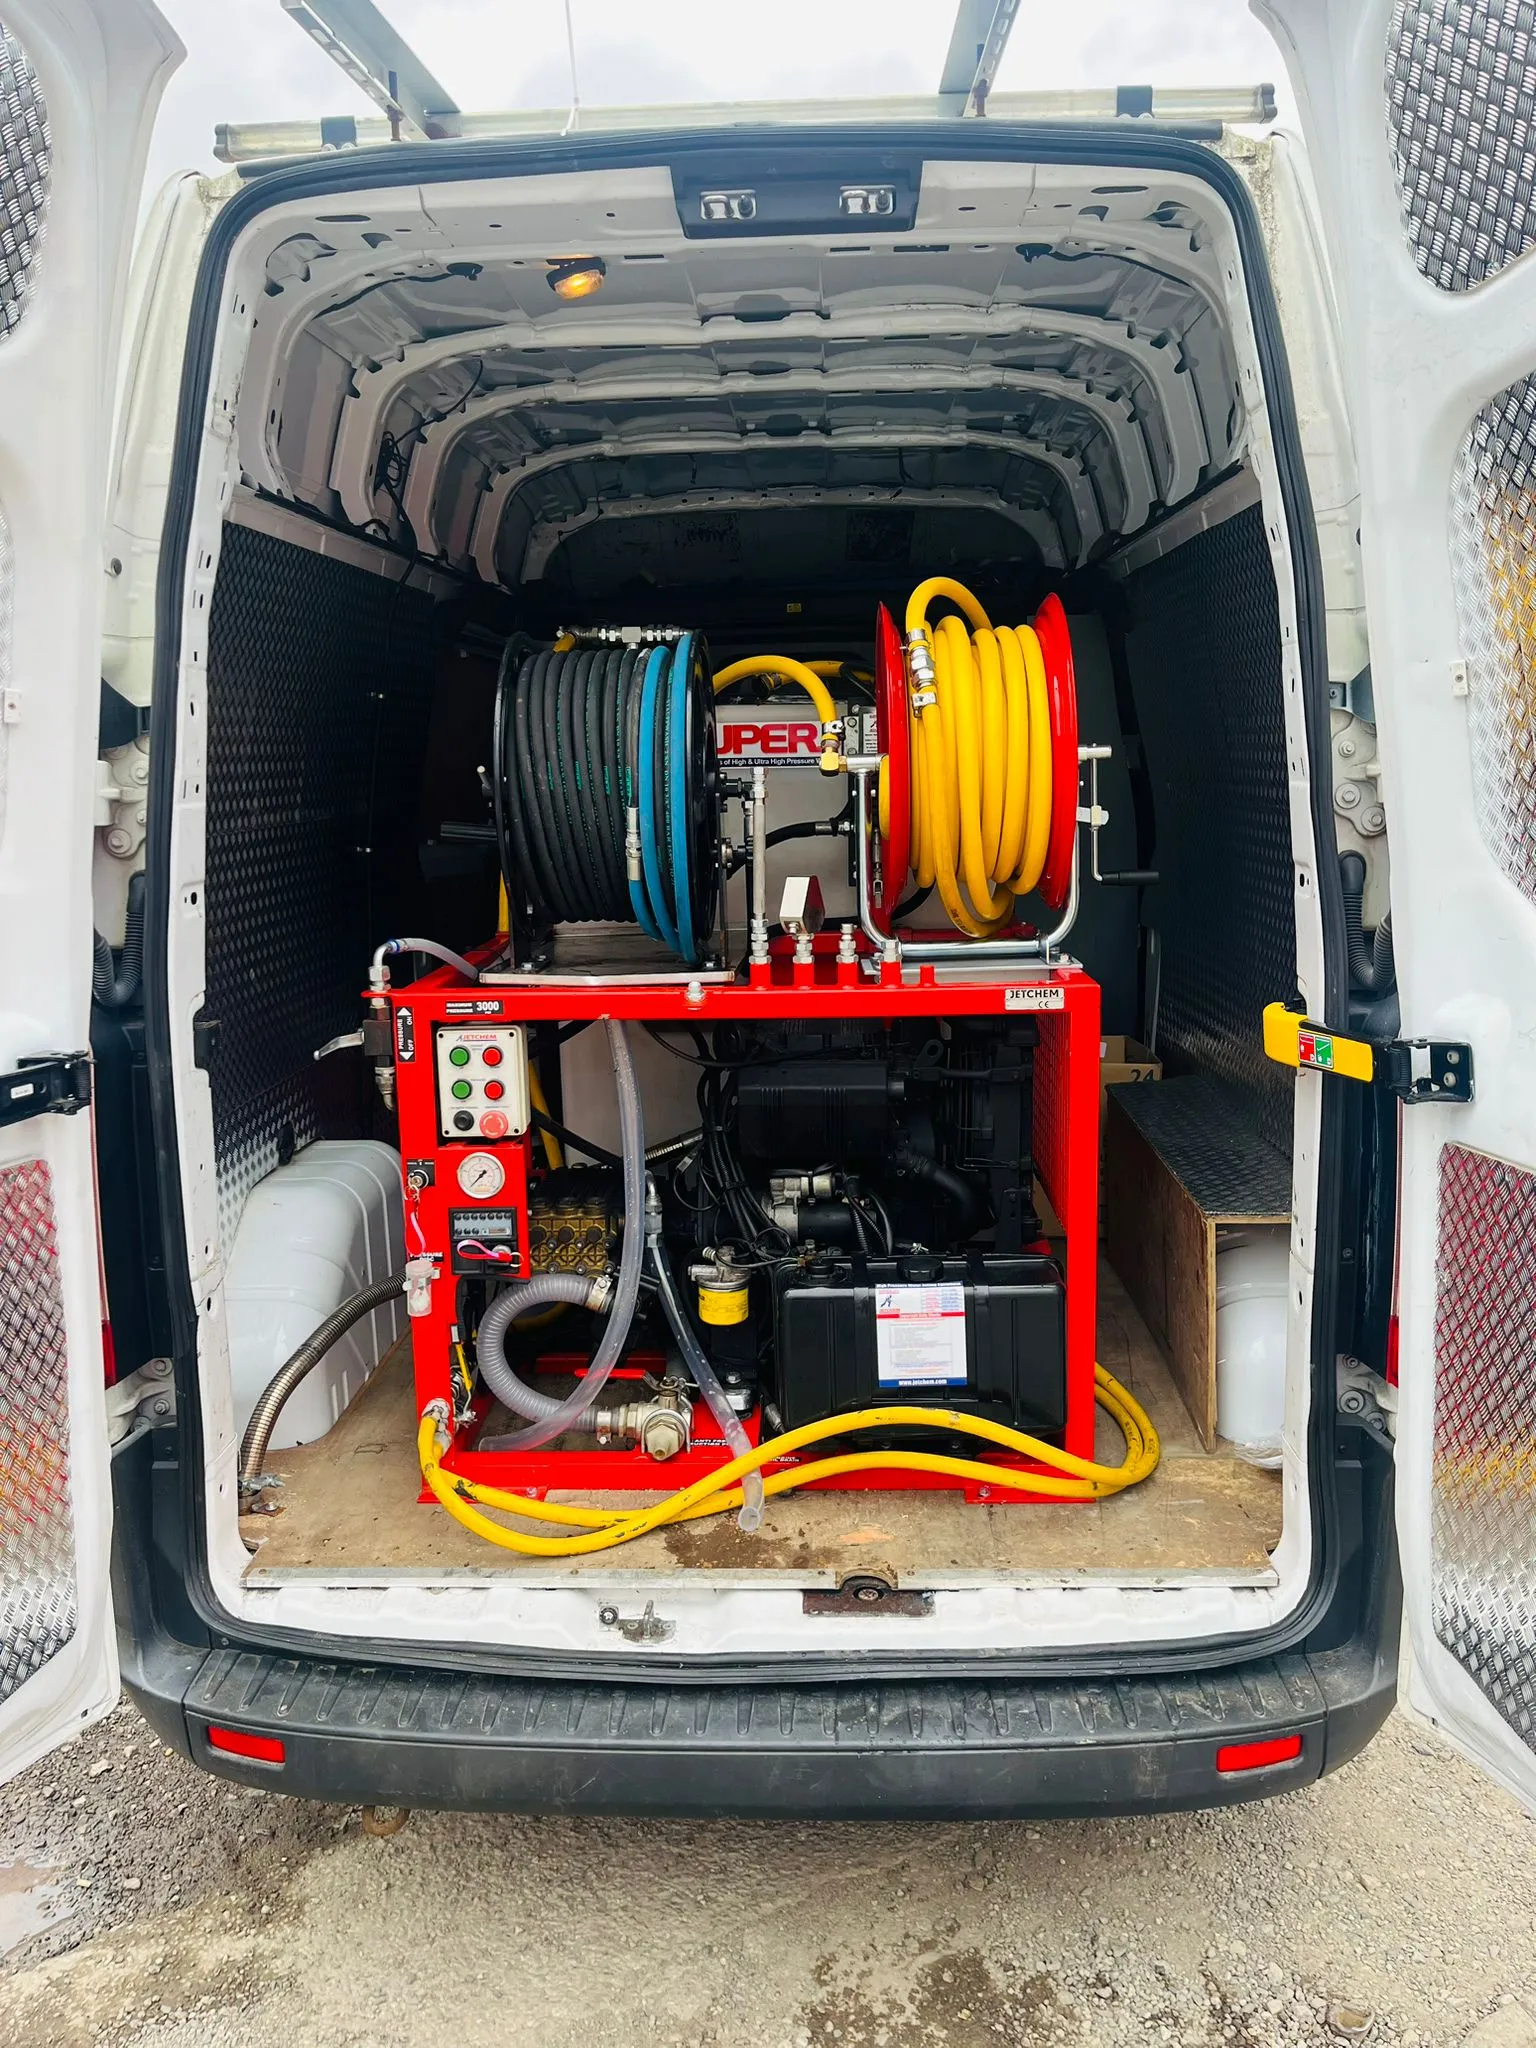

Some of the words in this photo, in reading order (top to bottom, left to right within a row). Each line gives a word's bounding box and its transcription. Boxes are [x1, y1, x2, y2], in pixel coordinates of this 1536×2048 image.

[732, 758, 746, 766] High
[770, 758, 786, 766] High
[786, 756, 814, 764] Pressure
[1010, 989, 1059, 999] JETCHEM
[476, 1002, 499, 1011] 3000
[406, 1016, 413, 1025] ON
[898, 1378, 948, 1386] www.jetchem.com
